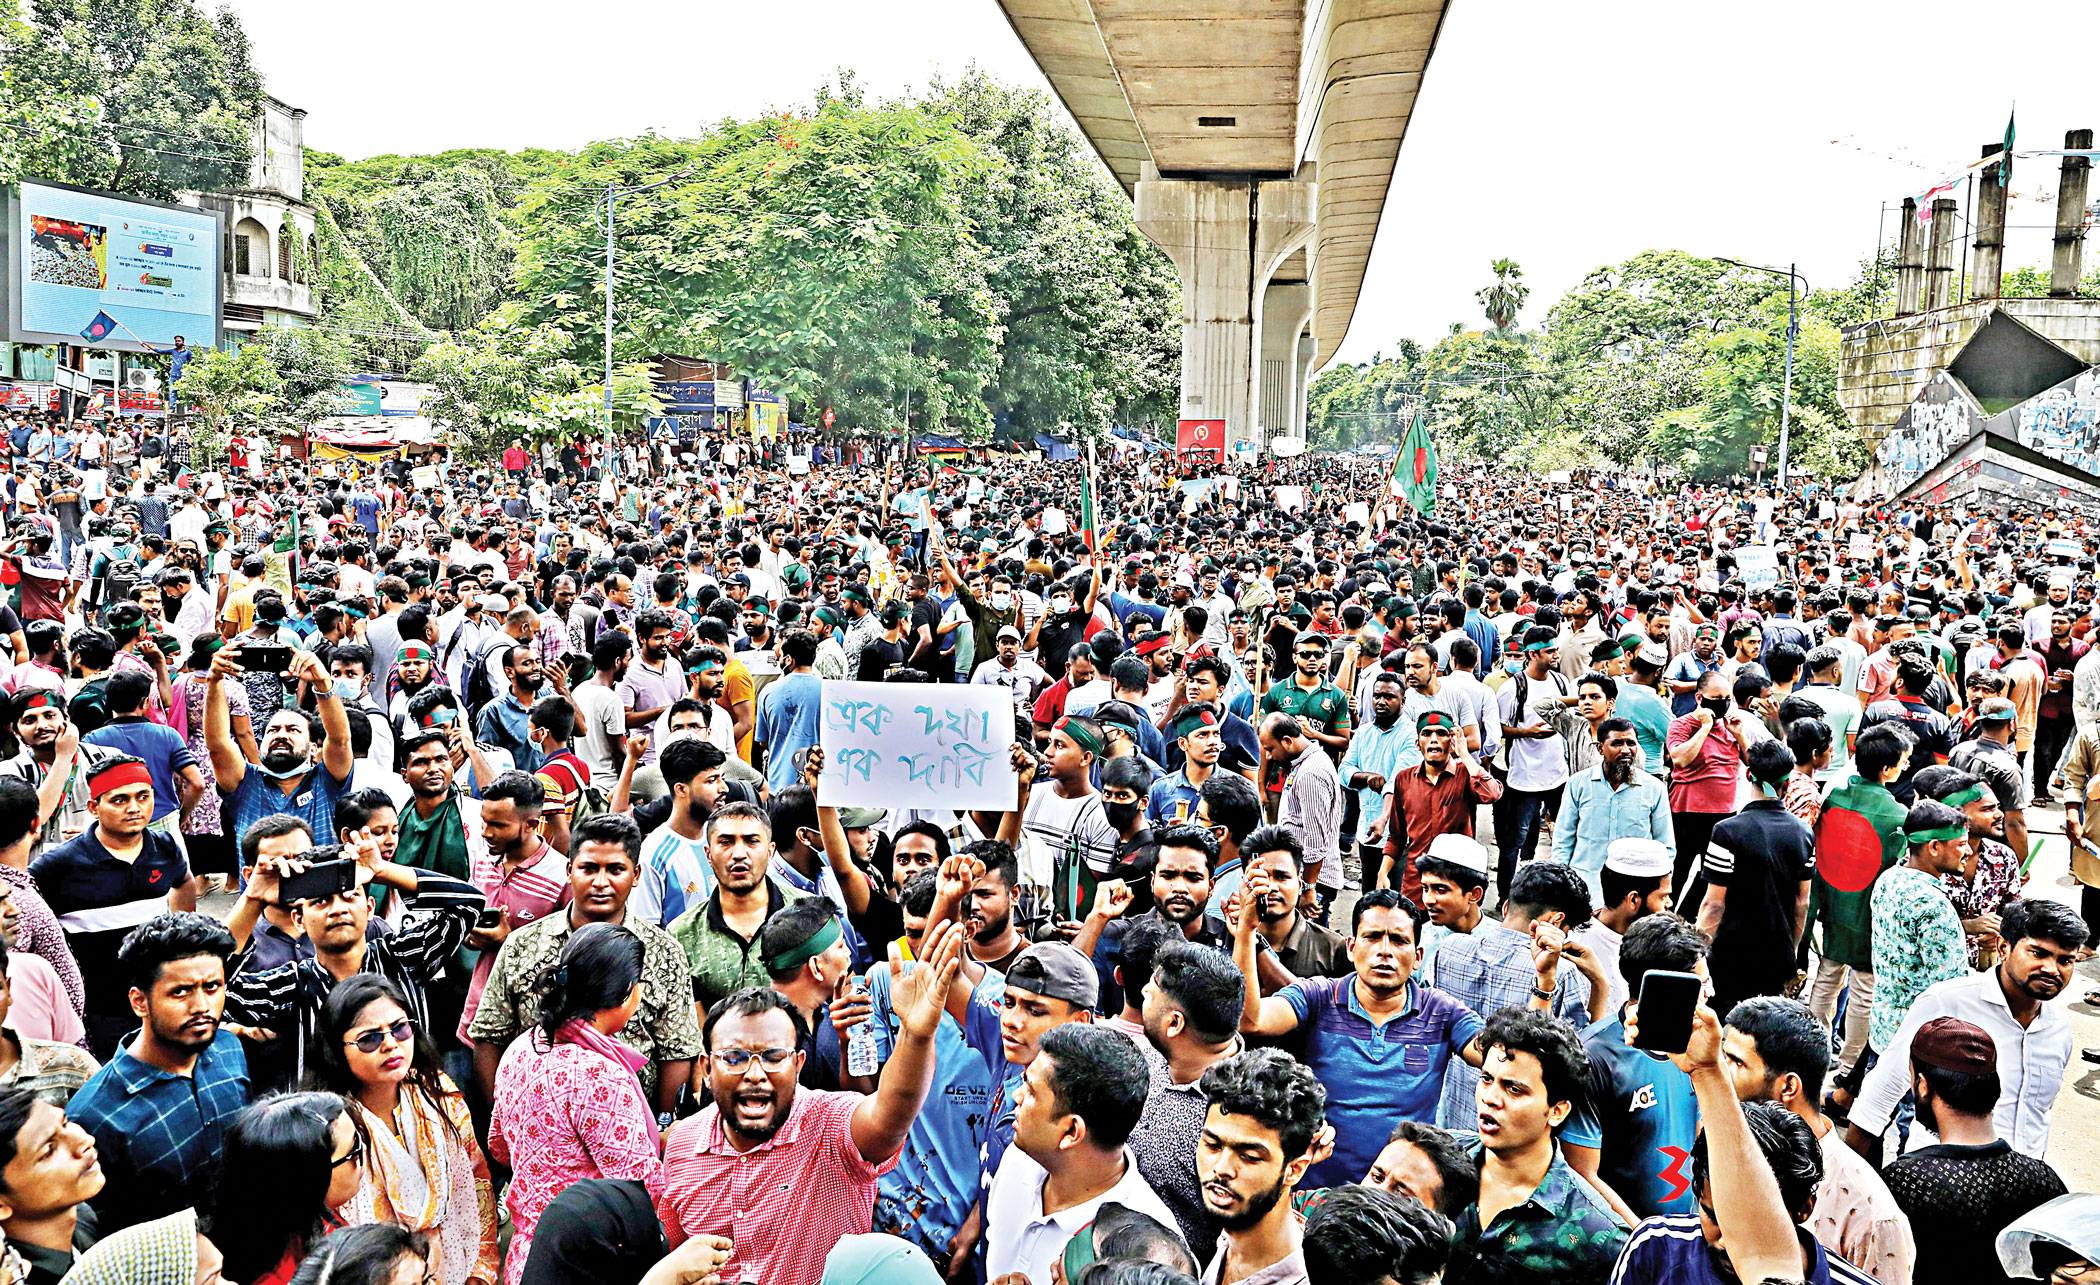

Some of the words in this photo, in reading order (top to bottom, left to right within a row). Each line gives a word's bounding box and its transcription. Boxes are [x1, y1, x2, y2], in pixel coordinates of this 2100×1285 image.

[827, 697, 893, 736] এক
[914, 705, 989, 746] দফা
[834, 748, 882, 786] এক
[897, 742, 1000, 792] দাবি
[945, 1085, 989, 1095] DEVI
